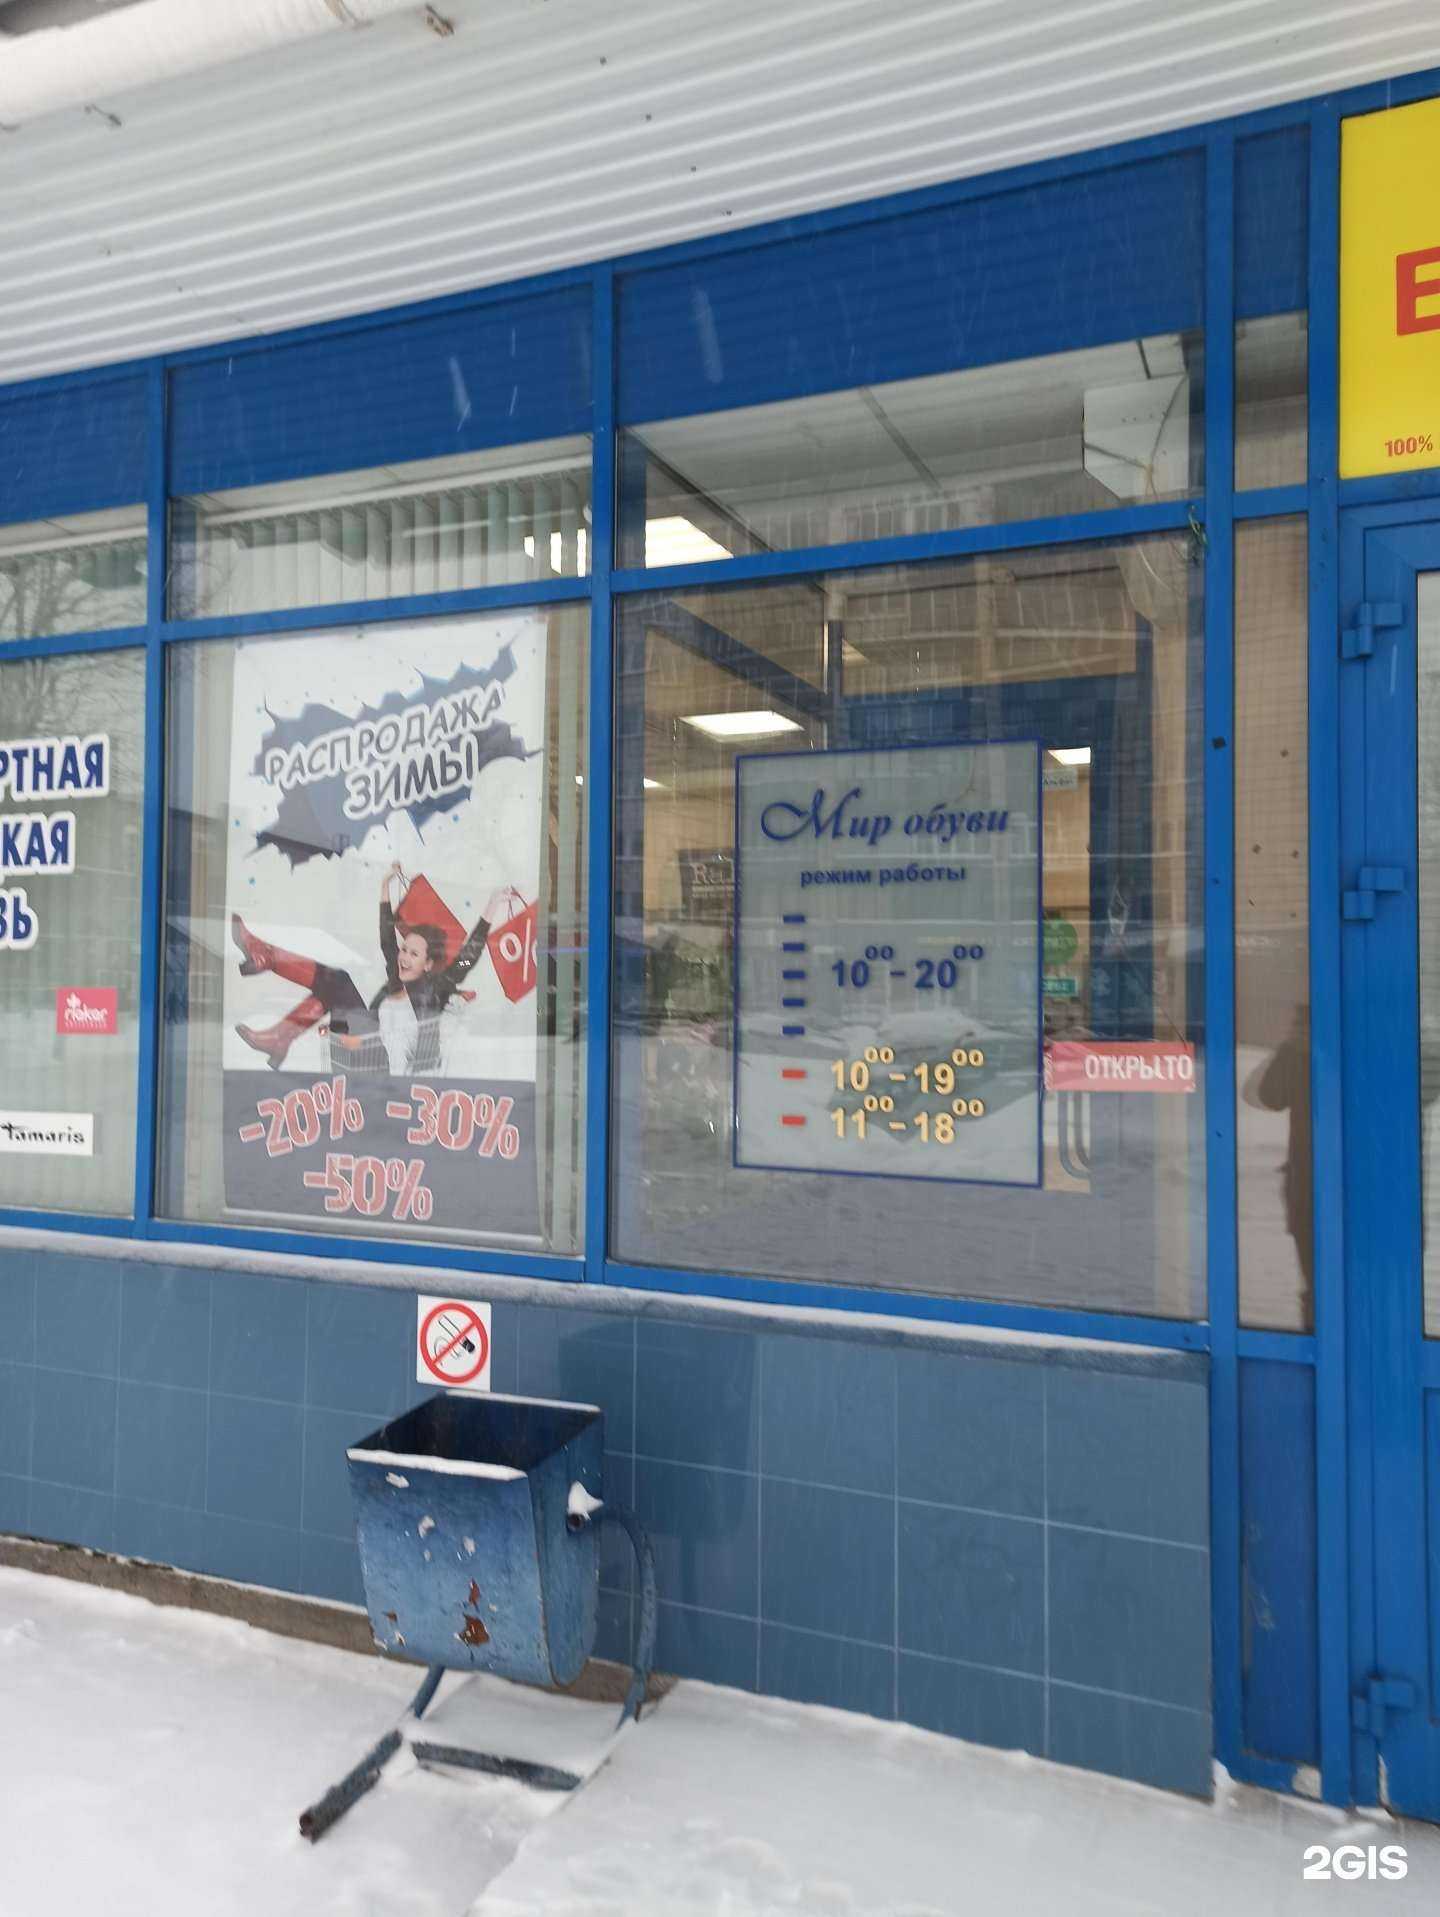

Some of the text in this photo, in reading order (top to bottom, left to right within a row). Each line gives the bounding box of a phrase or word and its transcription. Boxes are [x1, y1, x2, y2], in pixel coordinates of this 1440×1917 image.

[1384, 433, 1433, 457] 100%
[266, 682, 506, 787] РАСПРОДАЖА
[346, 738, 476, 817] ЗИМЫ
[761, 787, 1009, 846] Мир обуви
[800, 863, 966, 887] режим работы
[1084, 1054, 1193, 1080] ОТКРЫТО
[240, 1075, 520, 1160] -20% -30%
[304, 1153, 432, 1220] -50%
